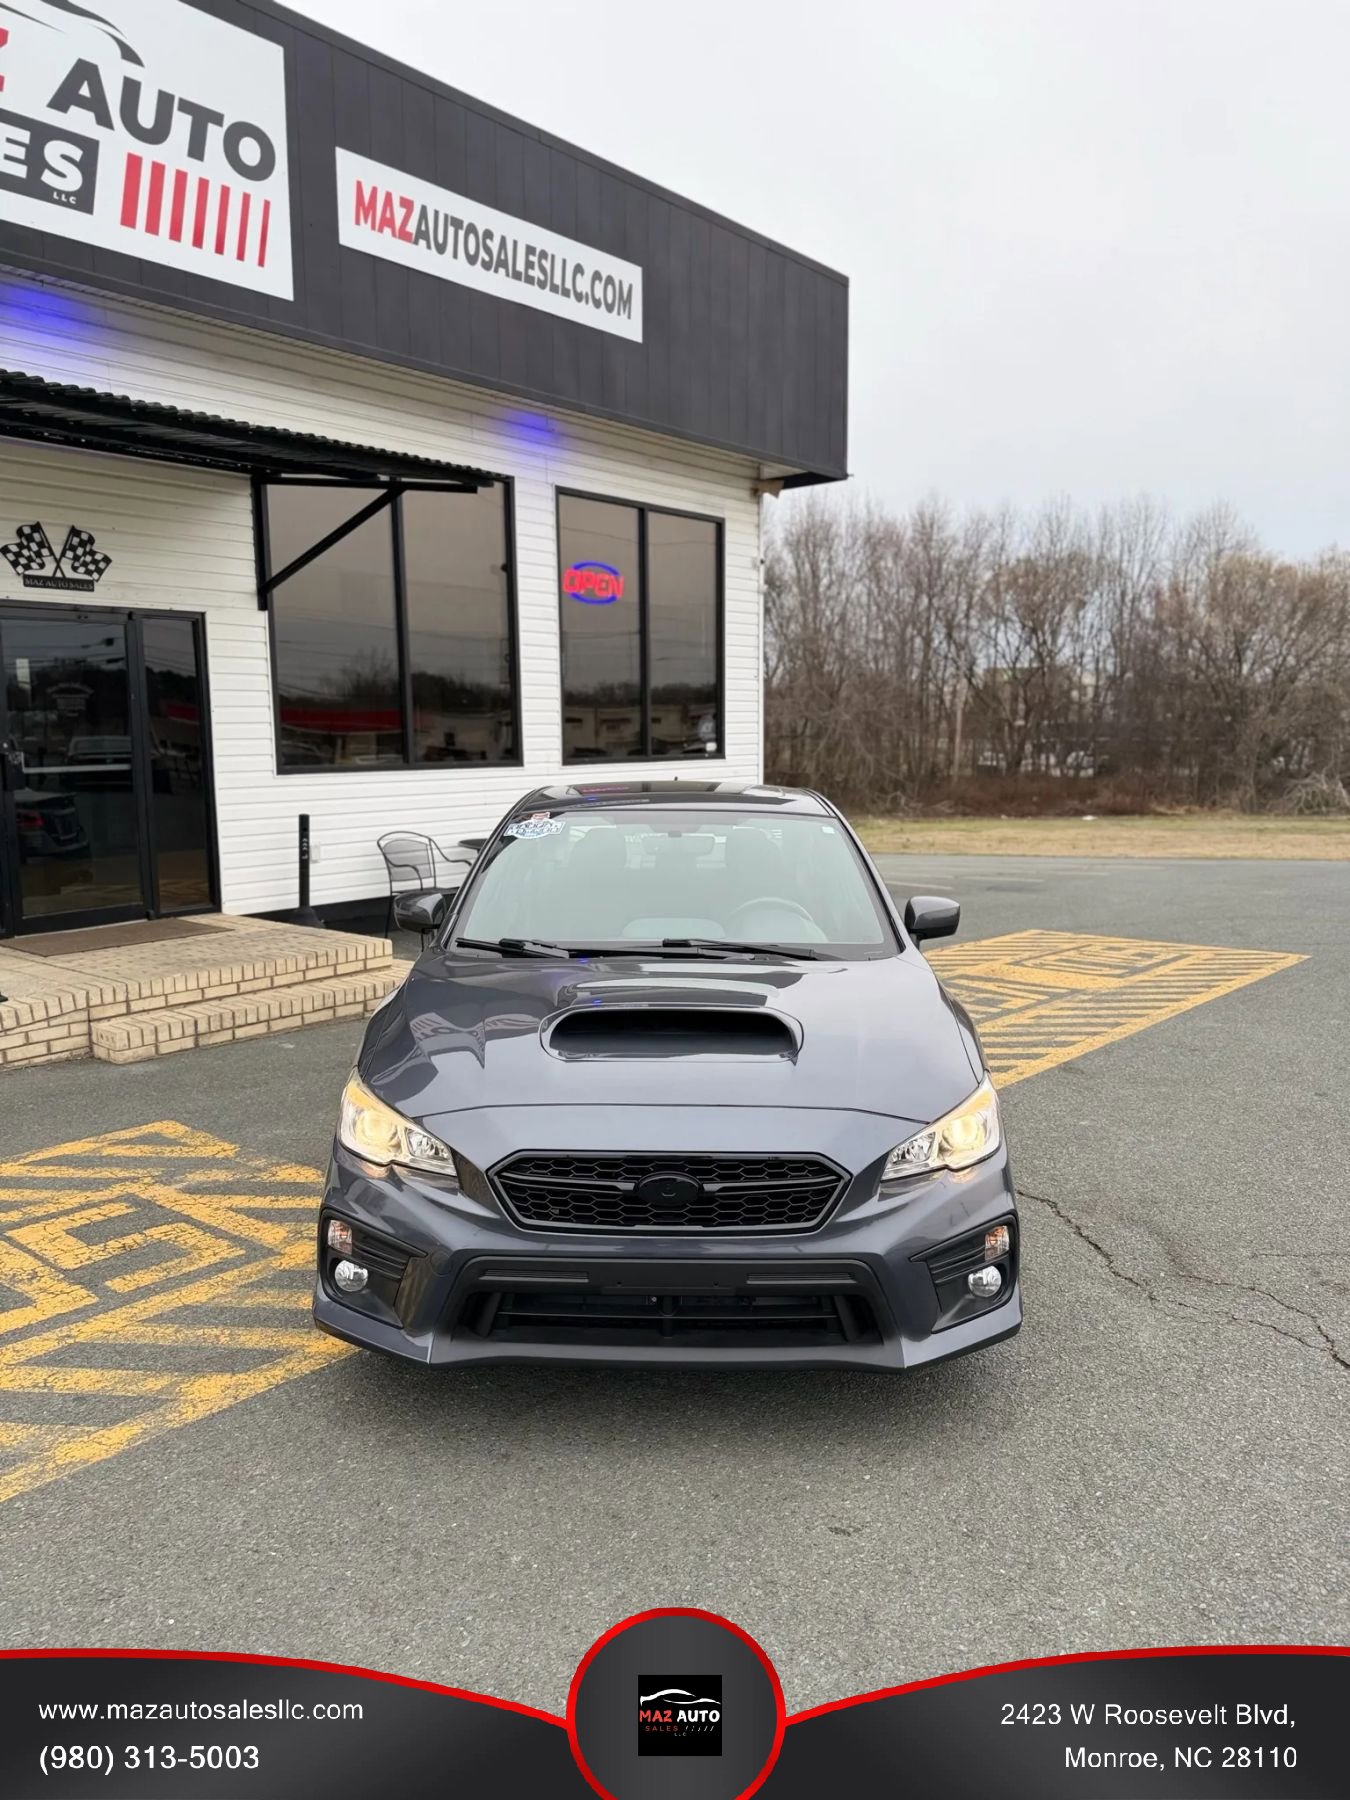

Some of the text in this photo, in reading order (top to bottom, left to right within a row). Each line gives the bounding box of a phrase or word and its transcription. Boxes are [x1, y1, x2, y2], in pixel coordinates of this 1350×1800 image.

[46, 57, 276, 182] AUTO
[53, 191, 77, 204] LLC
[354, 179, 633, 320] MAZAUTOSALESLLC.COM
[562, 567, 625, 599] OPEN
